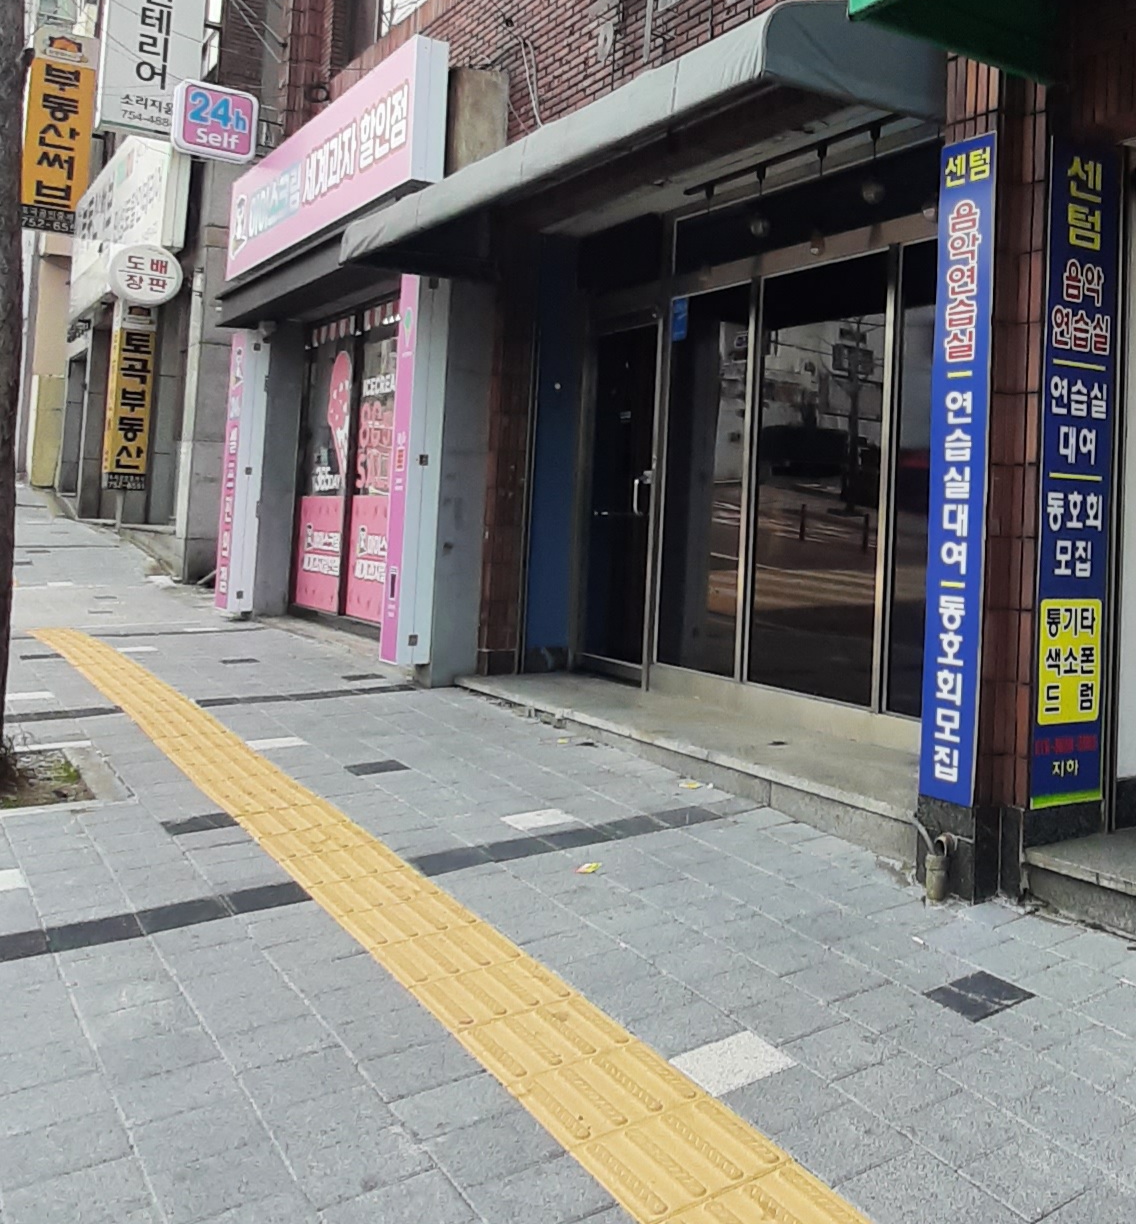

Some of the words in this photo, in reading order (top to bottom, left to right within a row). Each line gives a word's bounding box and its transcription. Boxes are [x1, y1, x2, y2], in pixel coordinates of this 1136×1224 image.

[188, 91, 248, 133] 24h
[34, 63, 81, 209] 부동산써브
[195, 127, 240, 150] Self
[302, 121, 357, 204] 세계과자
[359, 81, 409, 170] 할인점
[944, 146, 992, 189] 센텀
[1066, 155, 1103, 252] 센텀
[125, 274, 168, 294] 장판
[126, 255, 168, 275] 도배
[943, 198, 982, 363] 음악연습실
[1063, 258, 1105, 307] 음악
[1052, 305, 1111, 356] 연습실
[115, 331, 152, 471] 토곡부동산
[1050, 375, 1108, 420] 연습실
[1059, 426, 1097, 466] 대여
[940, 390, 973, 575] 연습실대여
[1046, 491, 1103, 533] 동호회
[1053, 539, 1092, 578] 모집
[1046, 607, 1097, 639] 통기타
[1045, 645, 1096, 678] 색소폰
[933, 593, 967, 784] 동호회모집
[1044, 683, 1095, 714] 드럼
[1051, 758, 1080, 778] 지하
